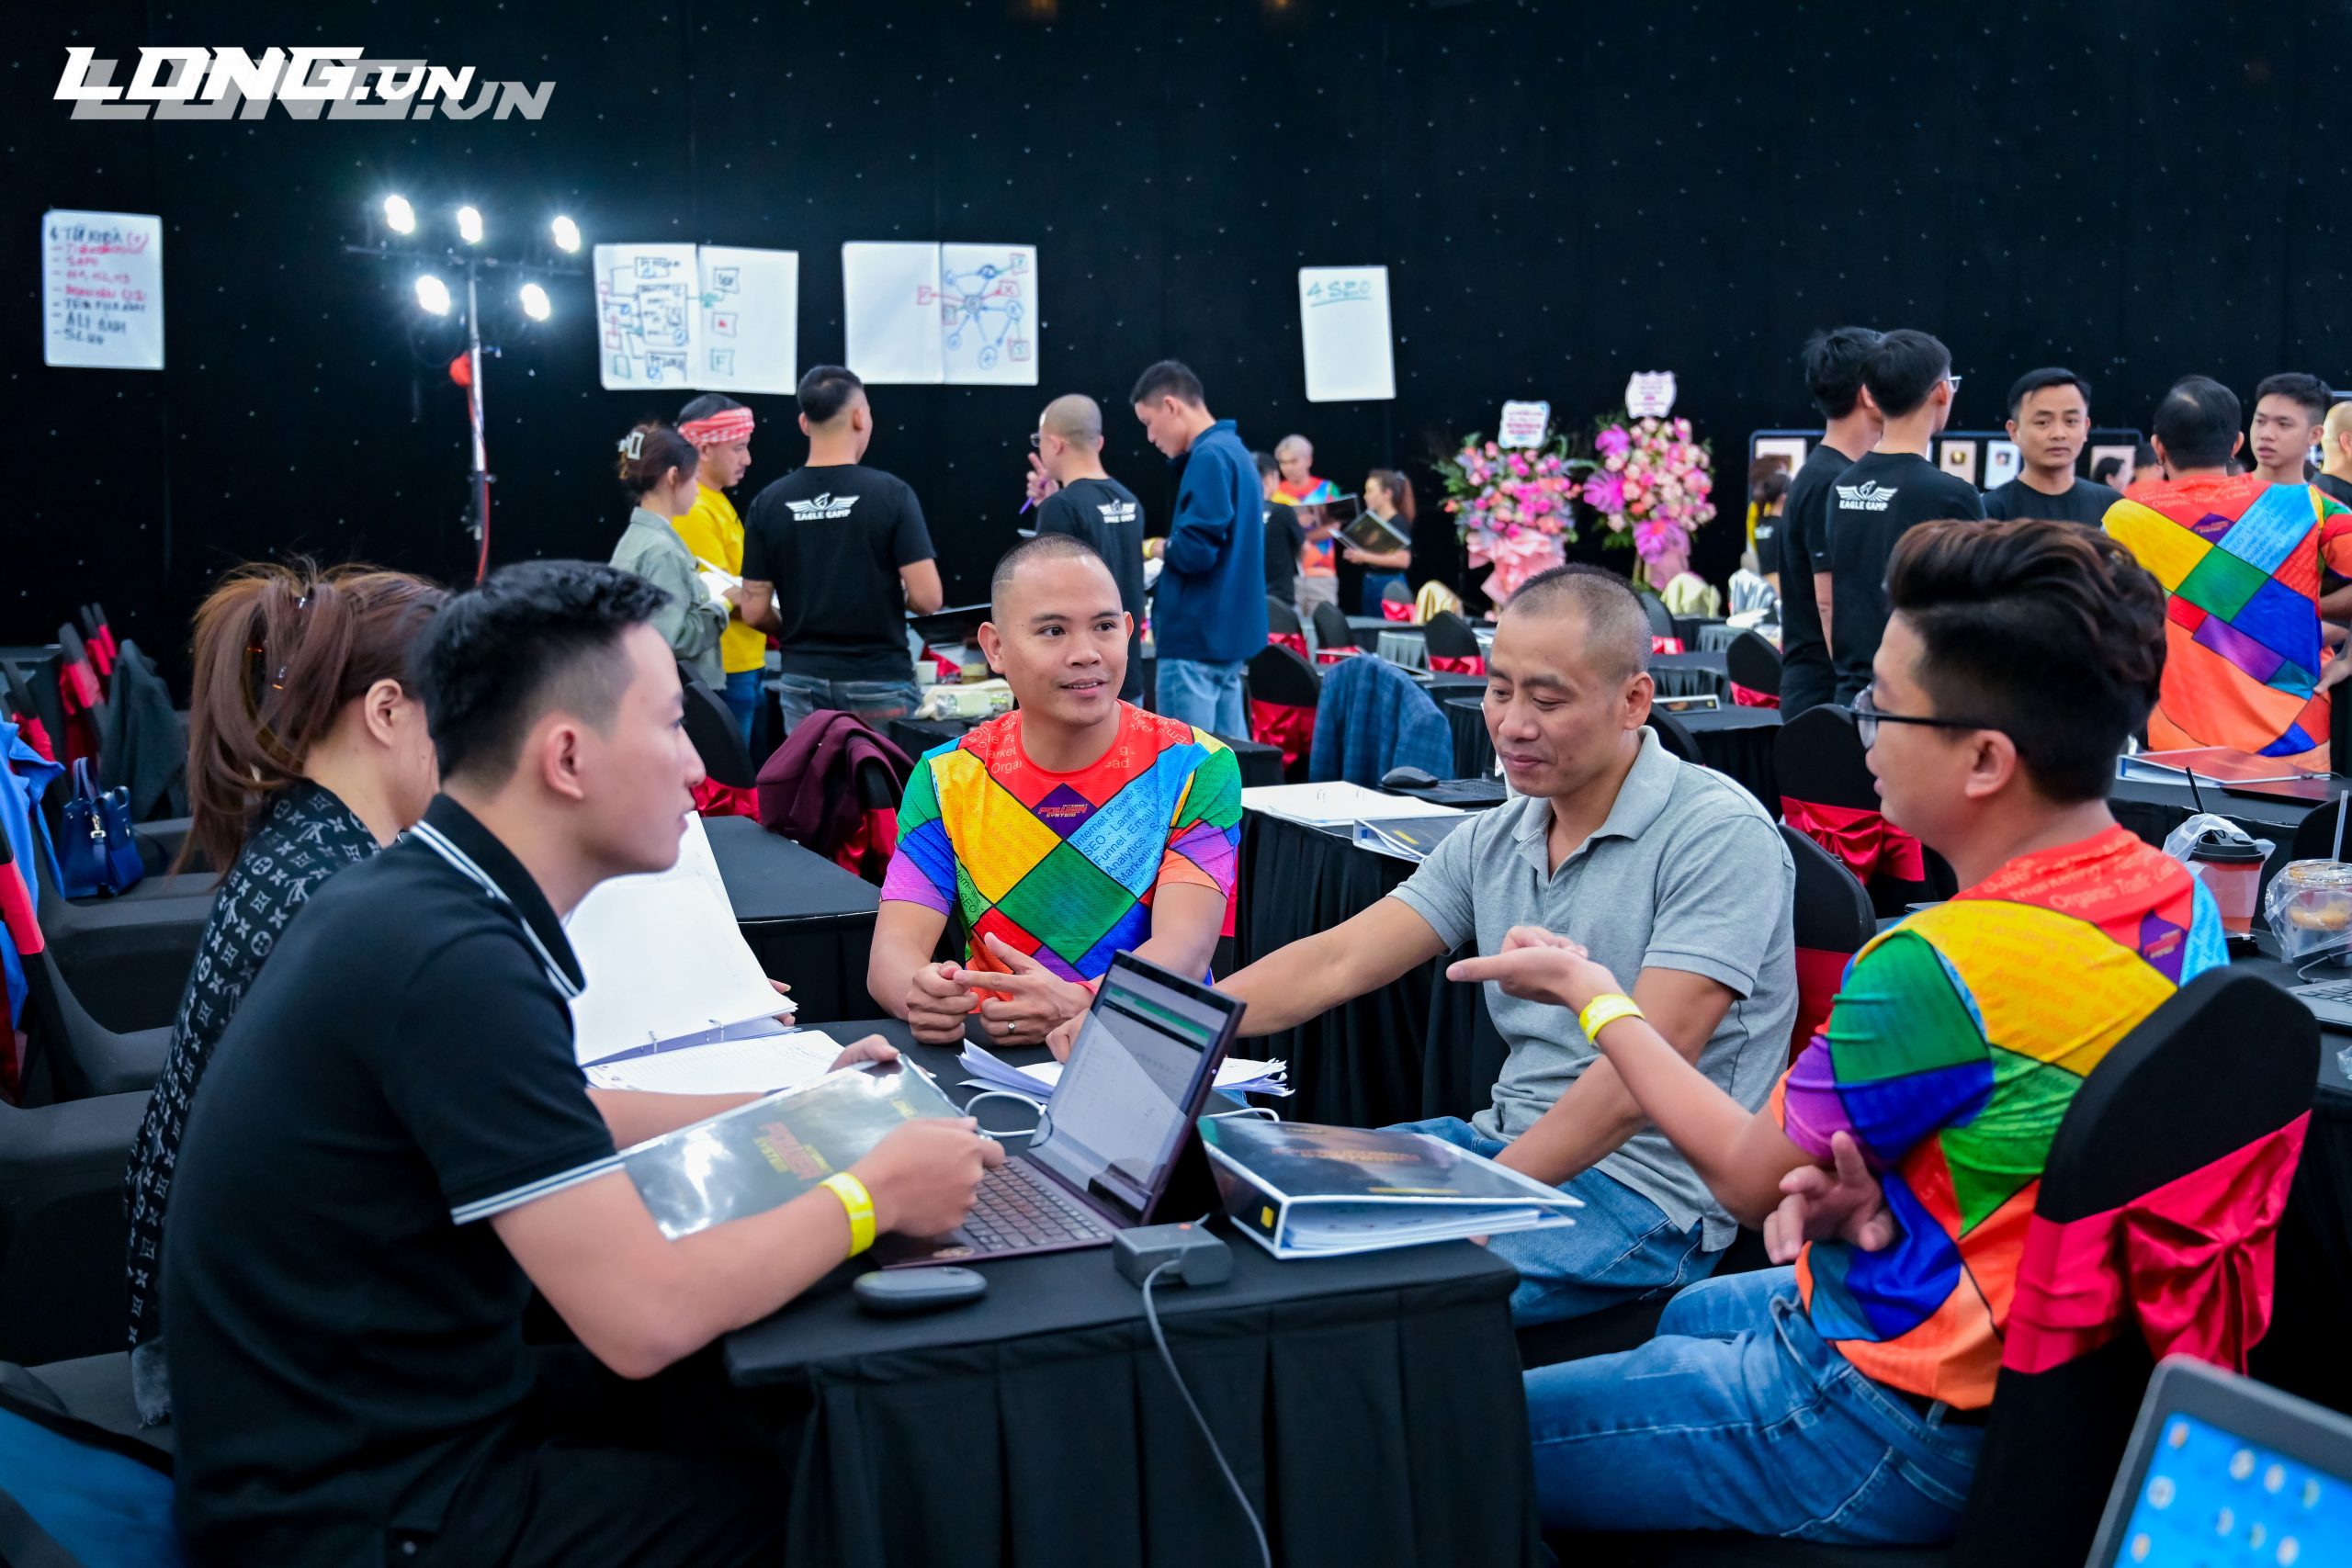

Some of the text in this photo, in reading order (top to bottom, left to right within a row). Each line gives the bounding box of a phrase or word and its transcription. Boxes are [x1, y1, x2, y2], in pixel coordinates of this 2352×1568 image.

[1327, 280, 1371, 298] SEO
[793, 508, 852, 522] EAGLE CAMP
[1838, 500, 1889, 512] EAGLE CAMP
[1105, 792, 1136, 818] Power
[1083, 834, 1106, 857] SEO
[1110, 800, 1148, 832] Landing
[1093, 835, 1127, 866] Funnel
[1105, 836, 1148, 875] Analytics
[1115, 841, 1159, 884] Marketing
